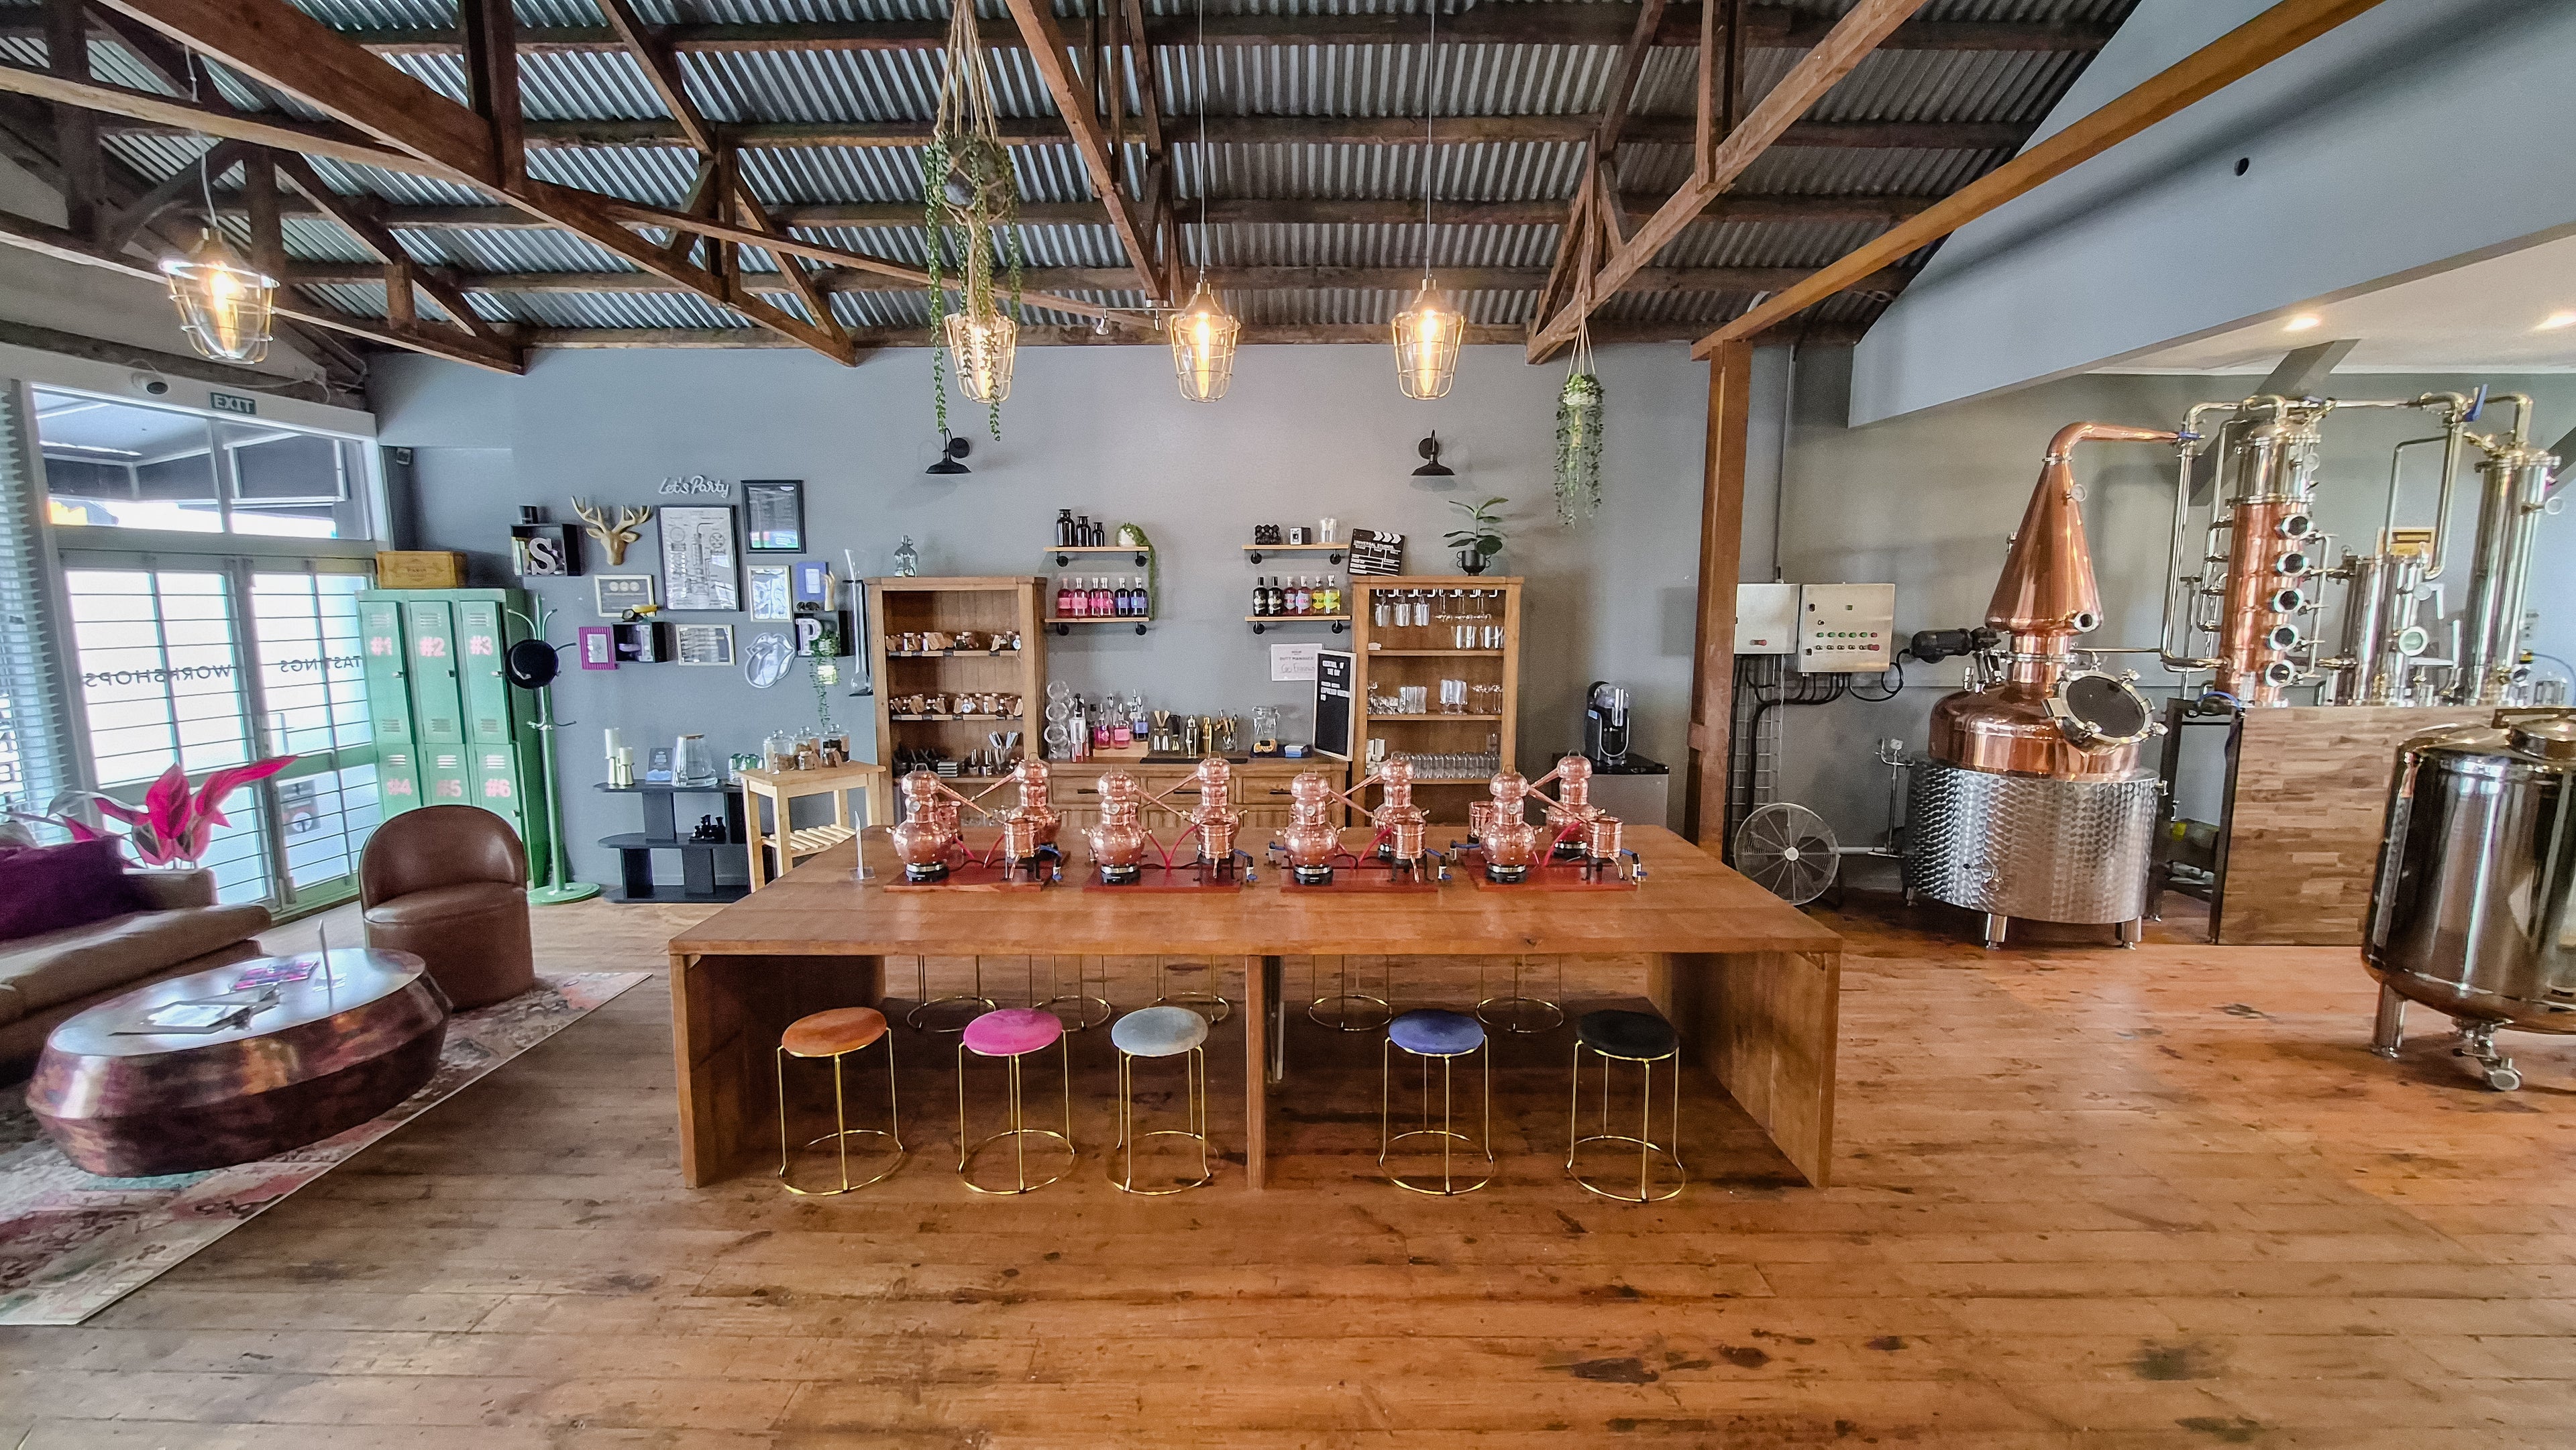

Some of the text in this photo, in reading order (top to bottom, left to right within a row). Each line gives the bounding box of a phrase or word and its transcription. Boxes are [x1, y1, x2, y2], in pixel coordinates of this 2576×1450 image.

[213, 394, 254, 412] EXIT
[658, 475, 729, 498] Let's Party
[529, 537, 556, 575] S
[370, 636, 392, 656] #1
[419, 636, 446, 657] #2
[470, 635, 493, 655] #3
[386, 778, 413, 795] #4
[437, 779, 462, 797] #5
[485, 778, 512, 797] #6
